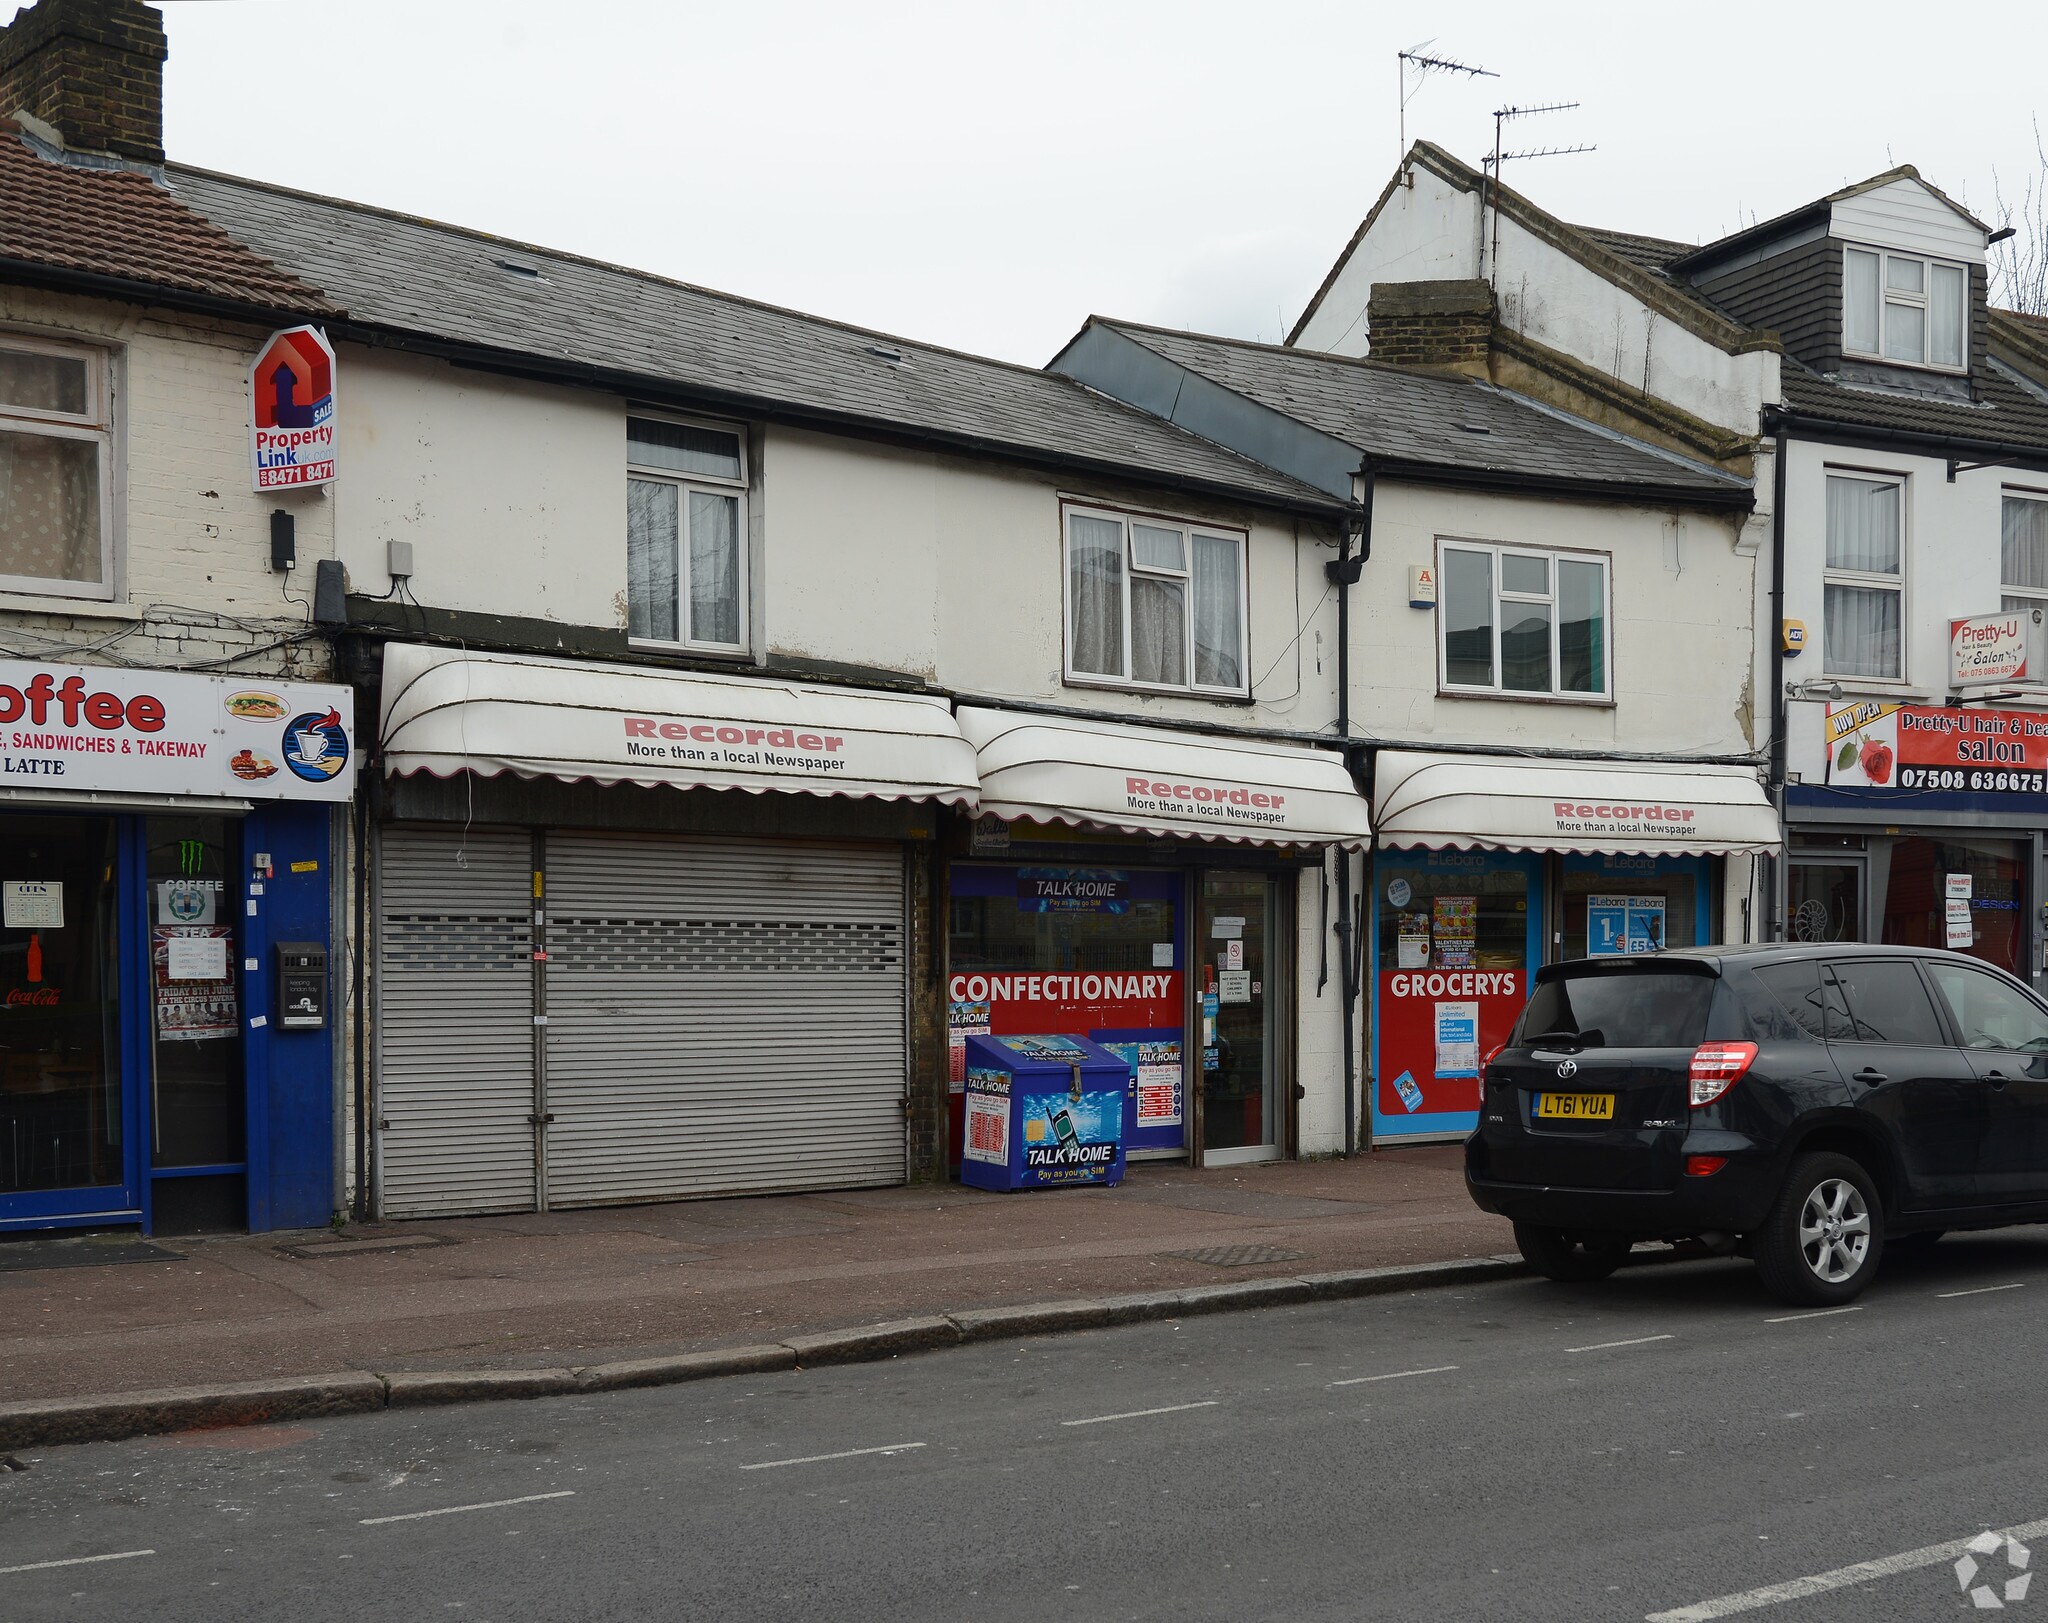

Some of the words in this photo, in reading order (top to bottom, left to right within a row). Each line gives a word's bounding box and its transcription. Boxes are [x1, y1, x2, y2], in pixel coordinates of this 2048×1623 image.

[314, 401, 332, 422] SALE
[256, 425, 333, 451] Property
[268, 466, 302, 485] 8471
[306, 460, 334, 481] 8471
[1789, 630, 1803, 639] ADT
[1962, 620, 2017, 643] Pretty-U
[1973, 651, 2004, 665] Salon
[1958, 670, 1969, 678] Tel:
[1984, 666, 1999, 675] 0863
[2001, 664, 2017, 674] 6675
[1832, 711, 1854, 735] NOW
[1856, 703, 1882, 723] OPEN
[1902, 713, 1970, 734] Pretty-U
[1974, 716, 2004, 734] hair
[2010, 718, 2021, 735] &
[623, 717, 844, 752] Recorder
[12, 732, 115, 754] SANDWICHES
[121, 739, 131, 754] &
[137, 739, 207, 759] TAKEWAY
[1957, 736, 2026, 764] salon
[626, 742, 666, 758] More
[671, 744, 706, 761] than
[710, 751, 719, 761] a
[724, 749, 760, 765] local
[765, 752, 845, 772] Newspaper
[4, 757, 65, 776] LATTE
[1902, 769, 1965, 790] 07508
[1970, 771, 2043, 793] 636675
[1125, 777, 1285, 810] Recorder
[1127, 796, 1156, 810] More
[1158, 799, 1184, 813] than
[1187, 804, 1194, 813] a
[1197, 803, 1223, 817] local
[1226, 806, 1285, 824] Newspaper
[1553, 802, 1695, 822] Recorder
[1557, 820, 1581, 831] More
[1584, 821, 1606, 832] than
[1609, 824, 1615, 832] a
[1617, 822, 1641, 833] local
[1643, 823, 1696, 836] Newspaper
[1439, 852, 1484, 866] Lebara
[1614, 857, 1656, 869] Lebara
[165, 880, 224, 891] COFFEE
[1036, 881, 1072, 896] TALK
[1075, 883, 1117, 897] HOME
[1050, 899, 1060, 907] Pay
[1596, 897, 1626, 906] Lebara
[1635, 898, 1664, 907] Lebara
[1973, 899, 2020, 909] DESIGN
[181, 927, 210, 938] TEA
[1630, 940, 1645, 952] £5
[158, 988, 191, 997] FRIDAY
[192, 987, 209, 996] 8TH
[211, 986, 235, 994] JUNE
[949, 974, 1172, 1002] CONFECTIONARY
[1391, 973, 1516, 997] GROCERYS
[962, 1013, 989, 1024] HOME
[1139, 1053, 1157, 1062] TALK
[1157, 1052, 1181, 1061] HOME
[968, 1078, 986, 1089] TALK
[986, 1081, 1010, 1094] HOME
[1544, 1096, 1576, 1114] LT61
[1581, 1096, 1607, 1116] YUA
[1642, 1119, 1676, 1127] RAV4
[1028, 1149, 1067, 1165] TALK
[1068, 1145, 1112, 1162] HOME
[1038, 1169, 1052, 1180] Pay
[1054, 1170, 1062, 1178] as
[1064, 1169, 1078, 1179] you
[1080, 1168, 1088, 1177] go
[1091, 1166, 1105, 1175] SIM
